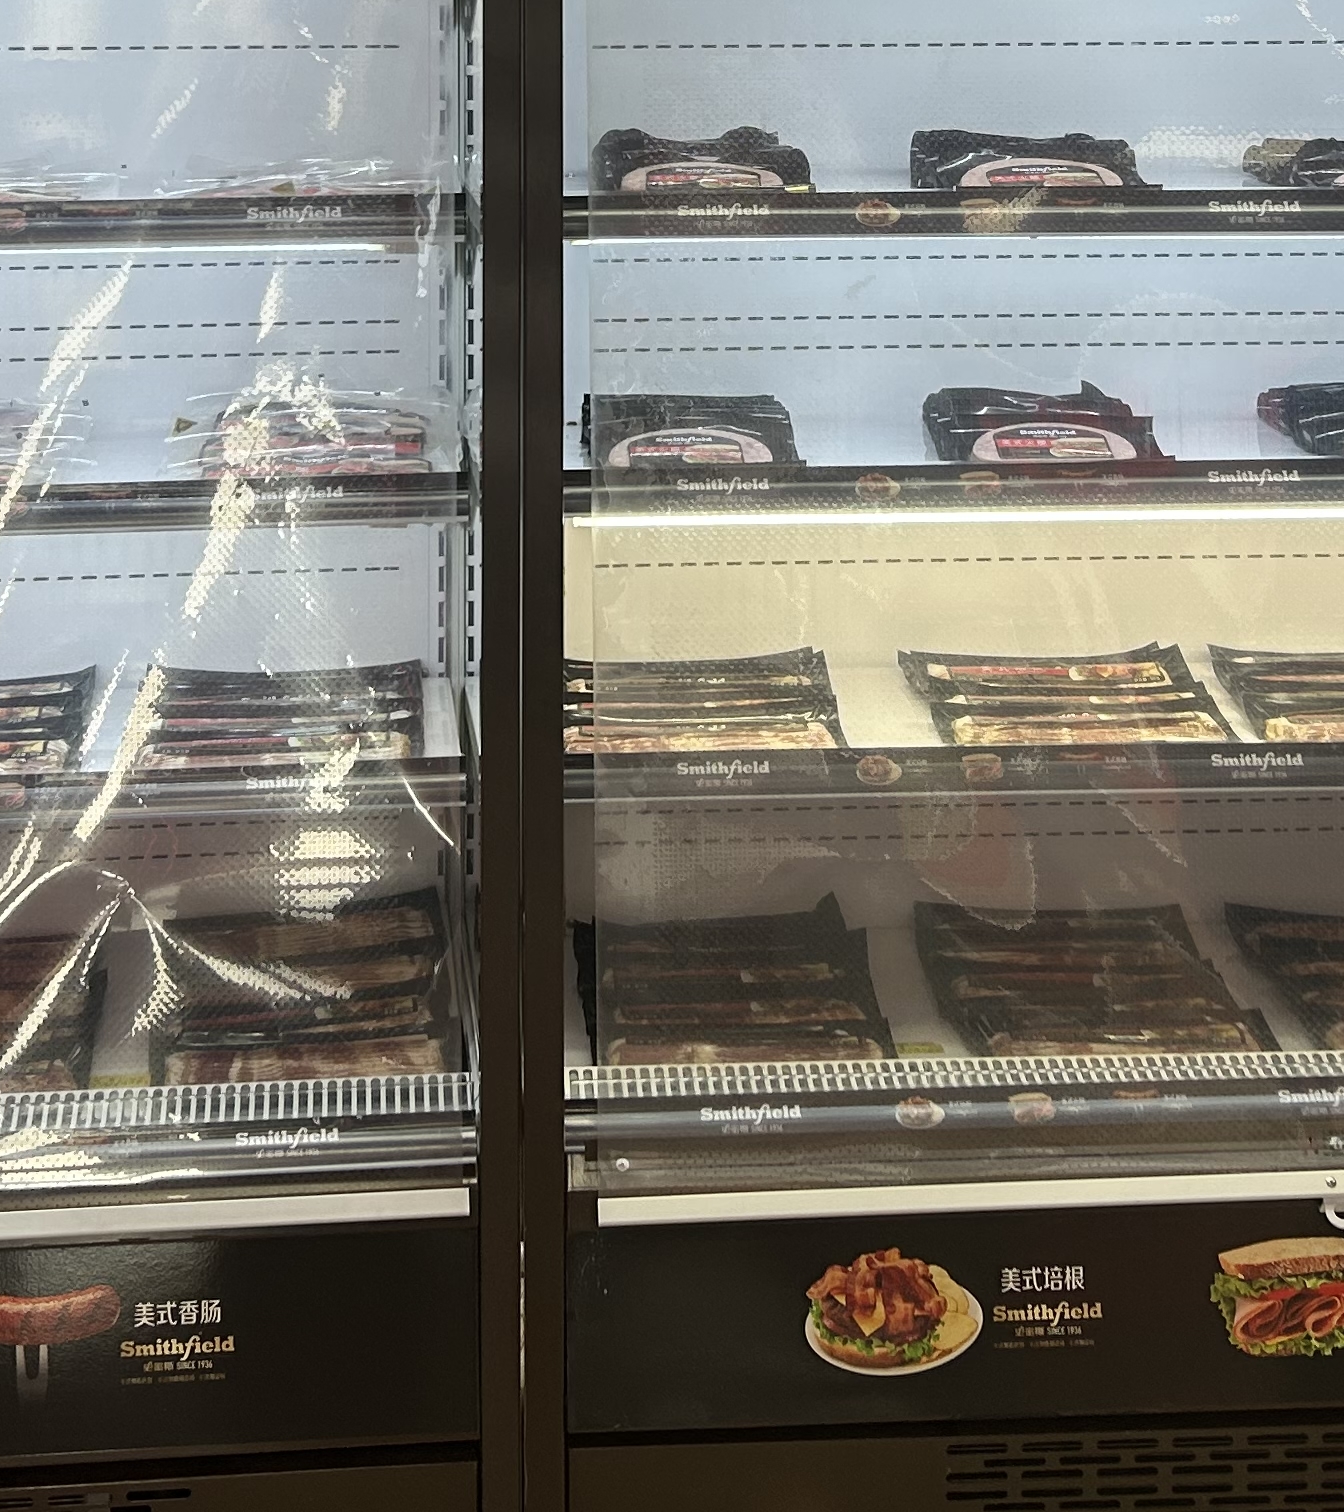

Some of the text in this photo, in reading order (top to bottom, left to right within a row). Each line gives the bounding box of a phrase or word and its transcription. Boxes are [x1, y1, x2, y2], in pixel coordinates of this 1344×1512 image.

[247, 205, 342, 223] Smithfield
[678, 203, 770, 220] Smithfield
[1209, 200, 1301, 216] Smithfield
[676, 476, 770, 494] Smithfield
[1208, 469, 1300, 486] Smithfield
[677, 759, 770, 778] Smithfield
[1211, 752, 1304, 770] Smithfield
[700, 1104, 801, 1124] Smithfield
[235, 1127, 339, 1148] Smithfield
[1000, 1265, 1085, 1293] 美式培根
[133, 1299, 222, 1328] 美式香肠
[992, 1301, 1103, 1327] Smithfield
[119, 1335, 235, 1361] Smithfield
